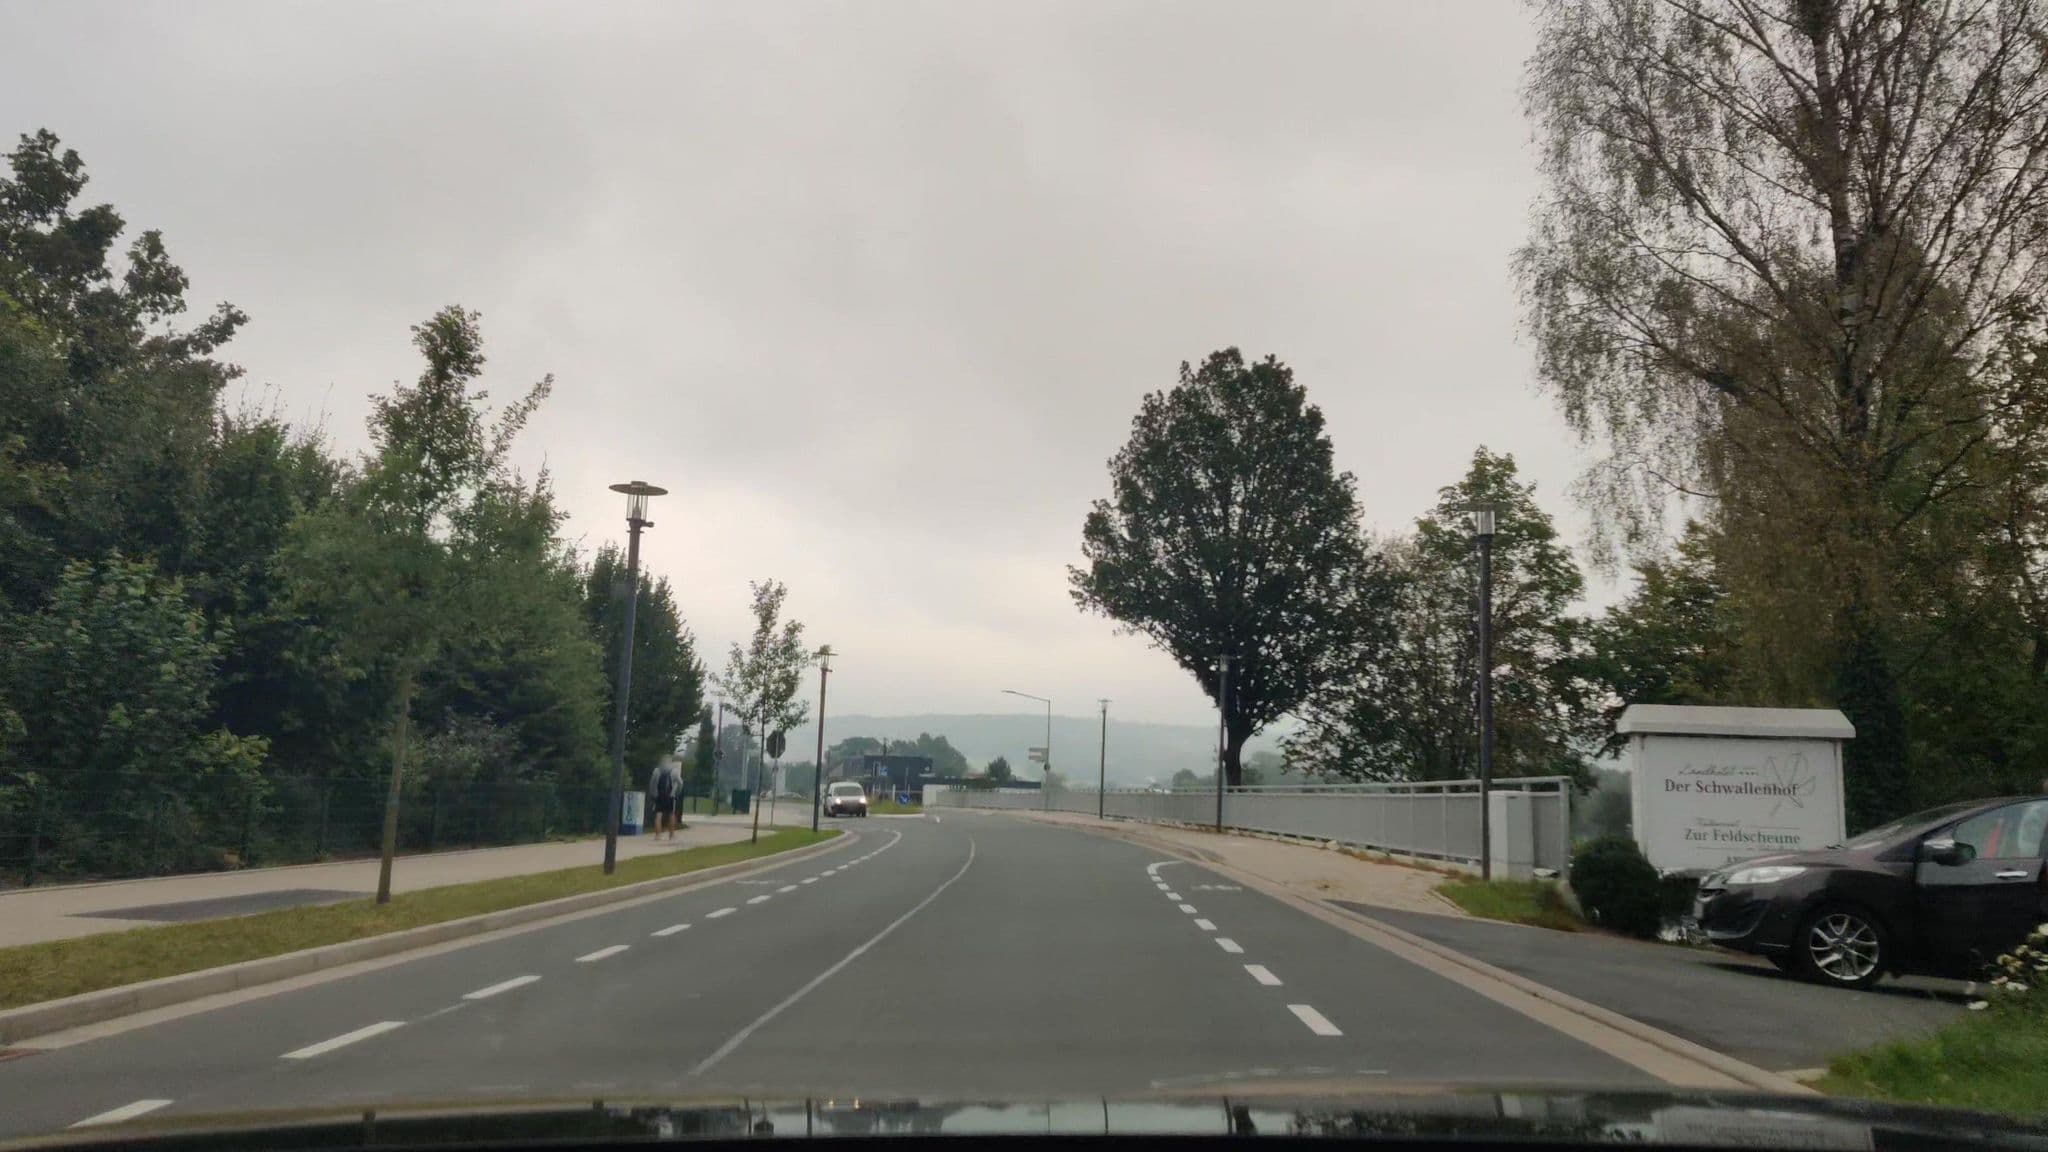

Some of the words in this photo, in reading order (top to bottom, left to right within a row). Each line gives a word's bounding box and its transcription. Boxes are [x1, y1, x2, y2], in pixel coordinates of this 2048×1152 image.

[1665, 778, 1691, 792] Der
[1695, 780, 1800, 796] Schwallenhof
[1685, 828, 1708, 841] Zur
[1713, 829, 1801, 844] Feldscheune
